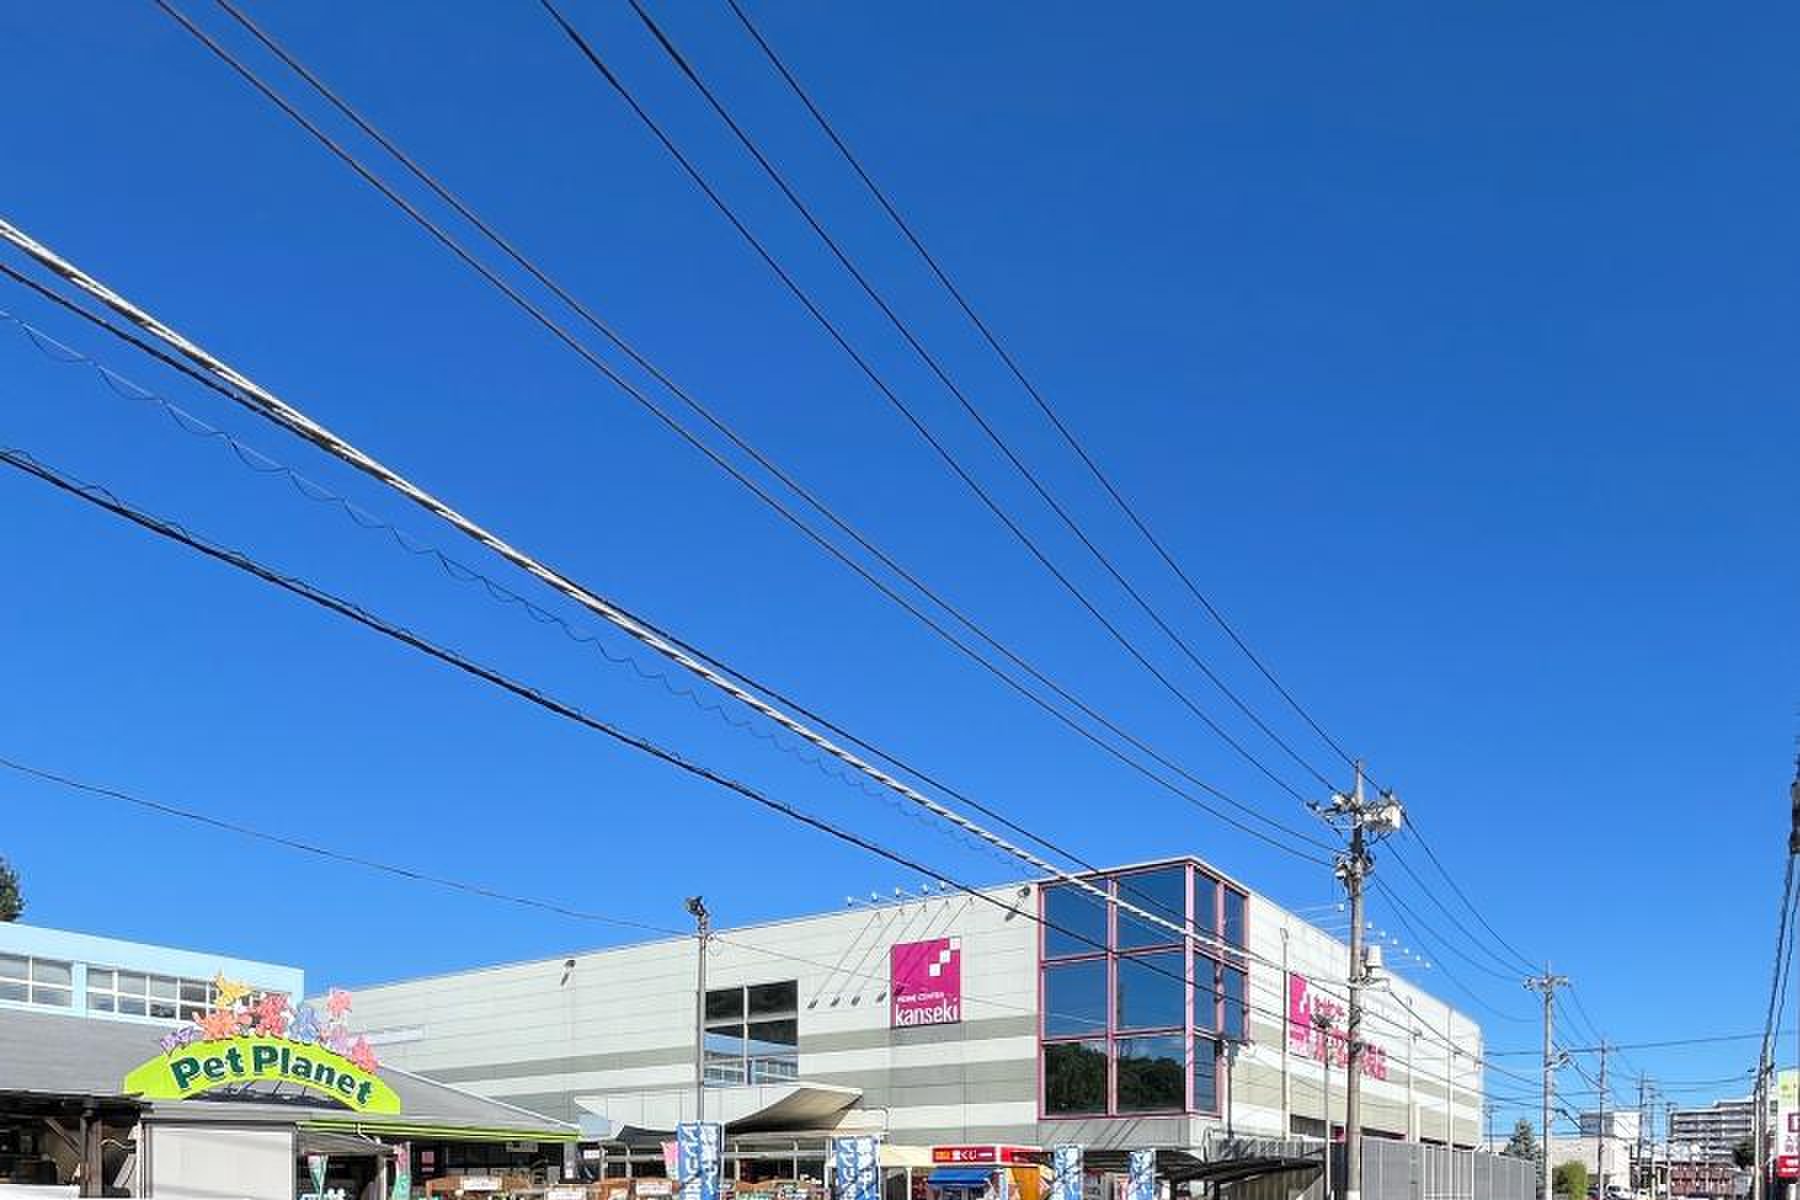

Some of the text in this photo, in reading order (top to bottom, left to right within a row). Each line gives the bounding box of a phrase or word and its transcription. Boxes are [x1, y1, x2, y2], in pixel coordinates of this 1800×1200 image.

[895, 997, 958, 1026] kanseki
[170, 1045, 372, 1105] Pet Planet
